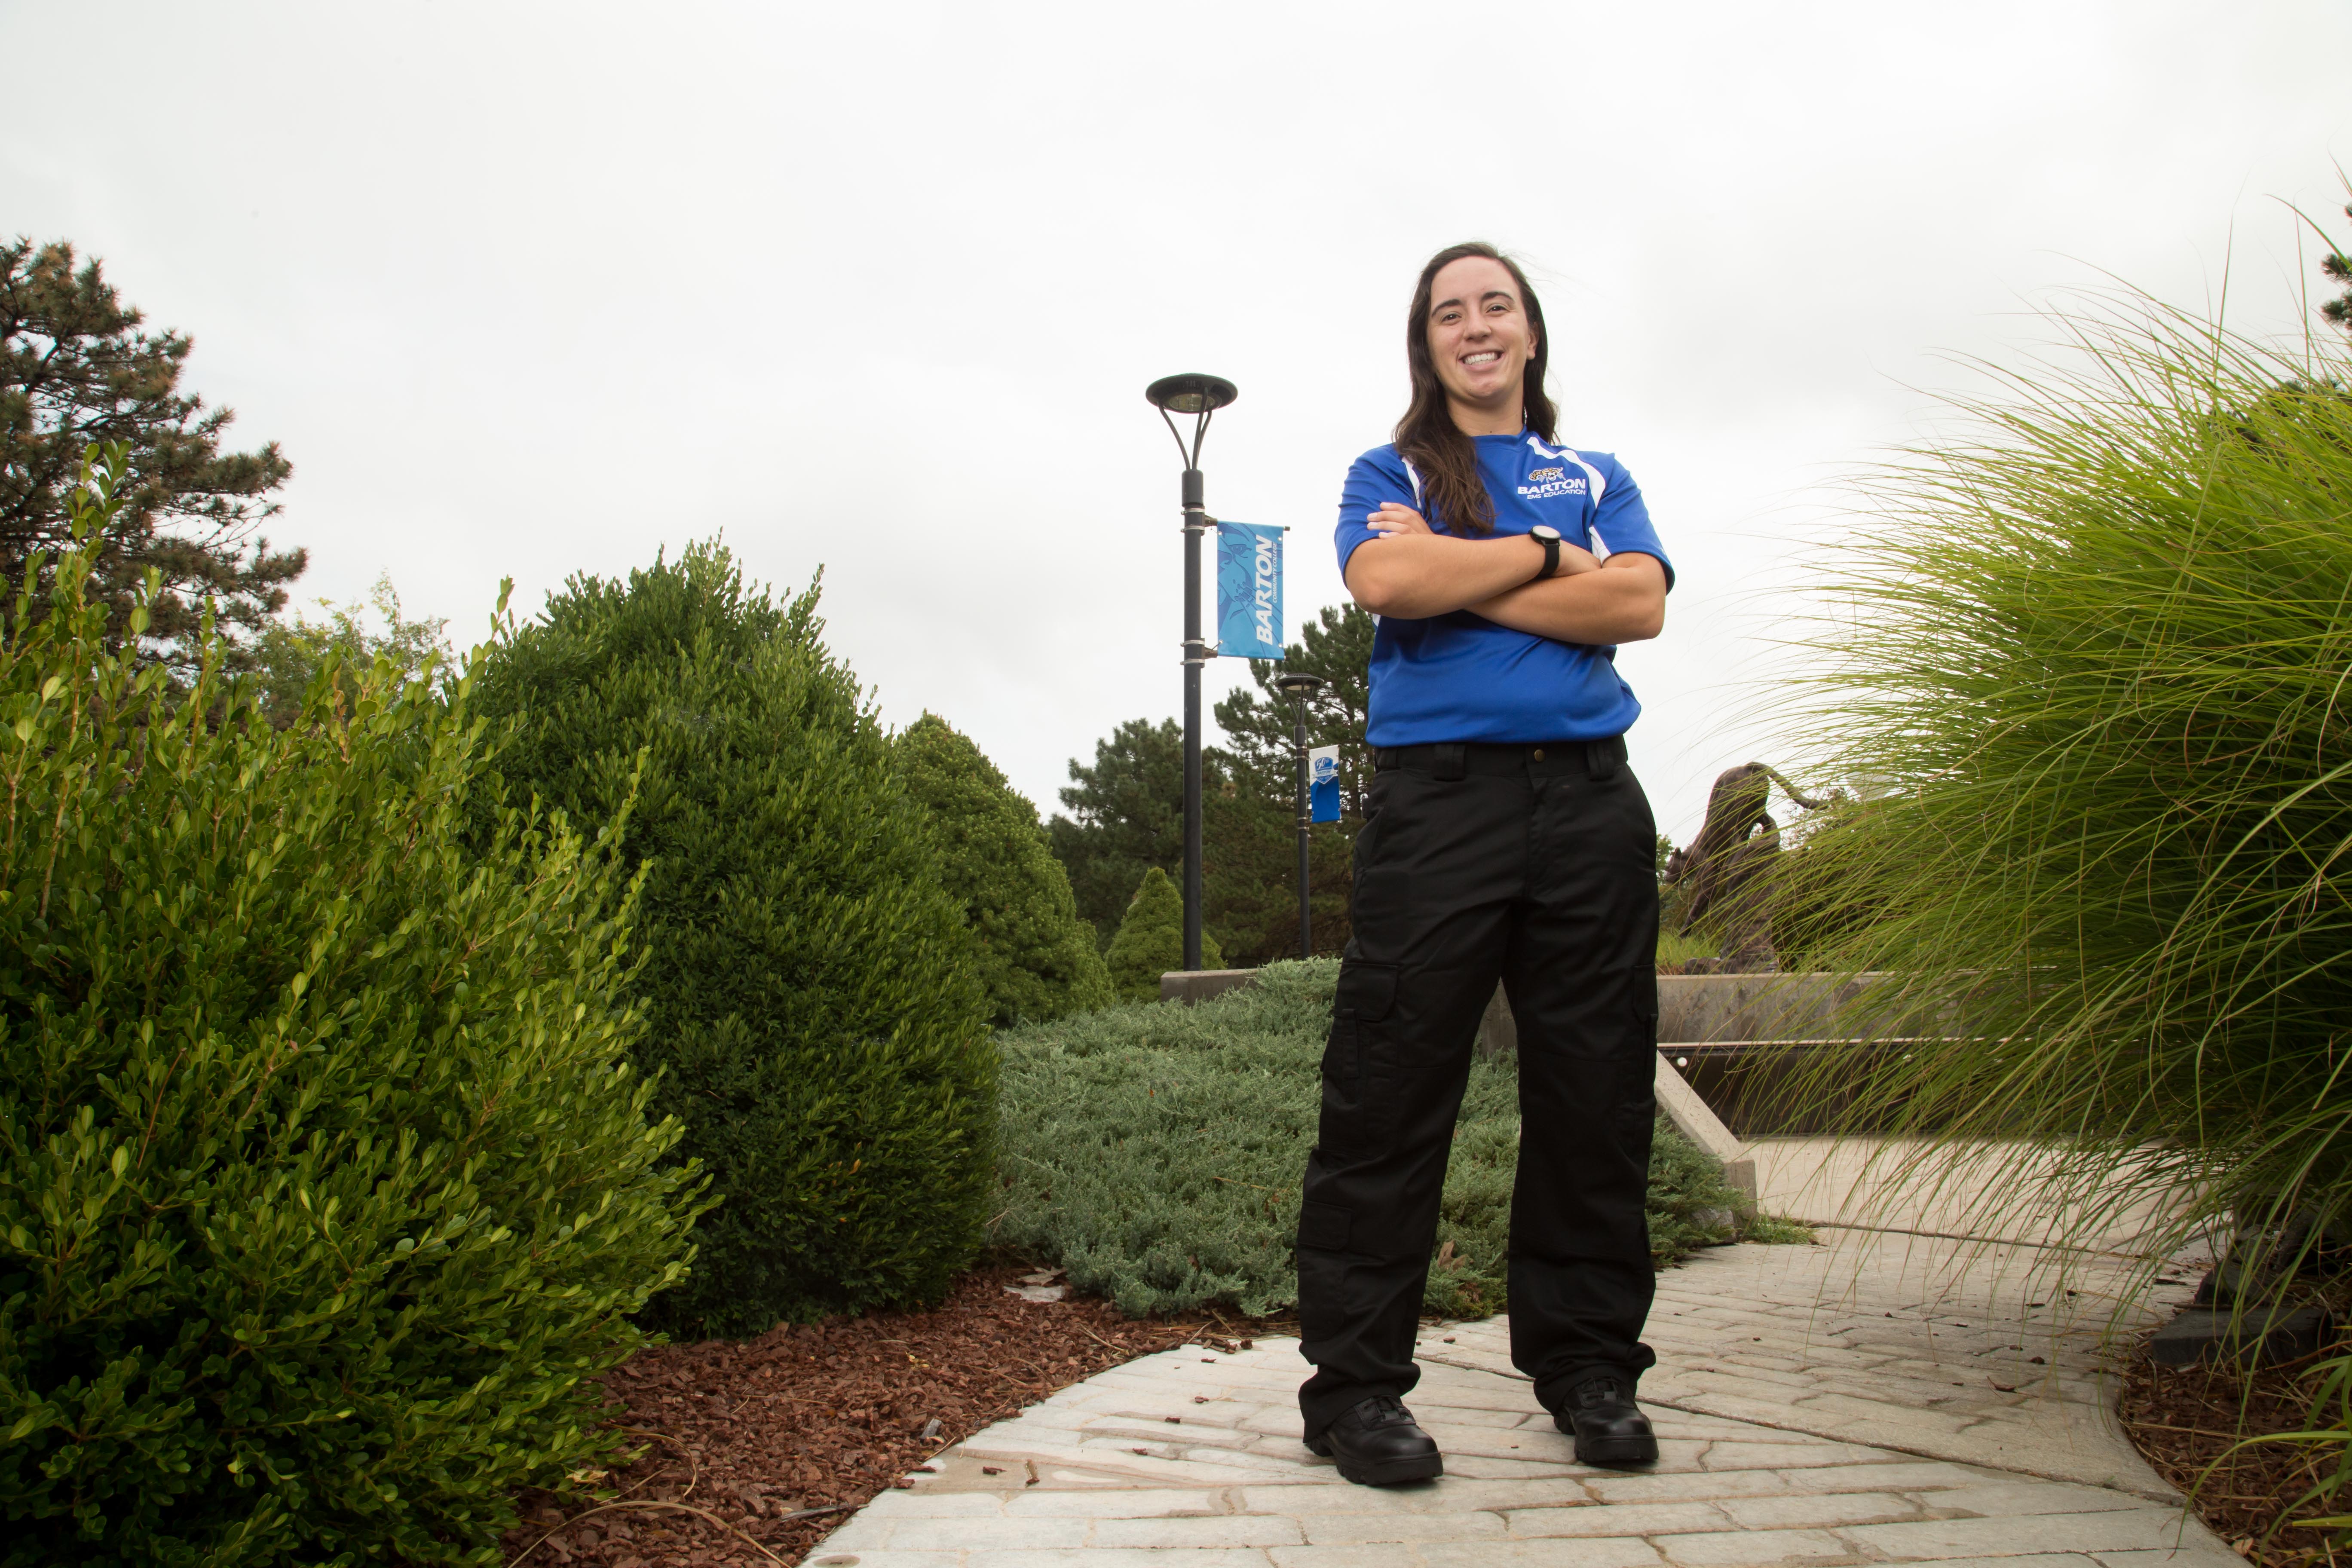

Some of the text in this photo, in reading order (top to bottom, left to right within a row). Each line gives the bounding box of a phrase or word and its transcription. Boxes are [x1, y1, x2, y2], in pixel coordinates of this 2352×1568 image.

[1518, 479, 1586, 494] BARTON
[1544, 489, 1586, 497] EDUCATION
[1256, 535, 1273, 645] BARTON
